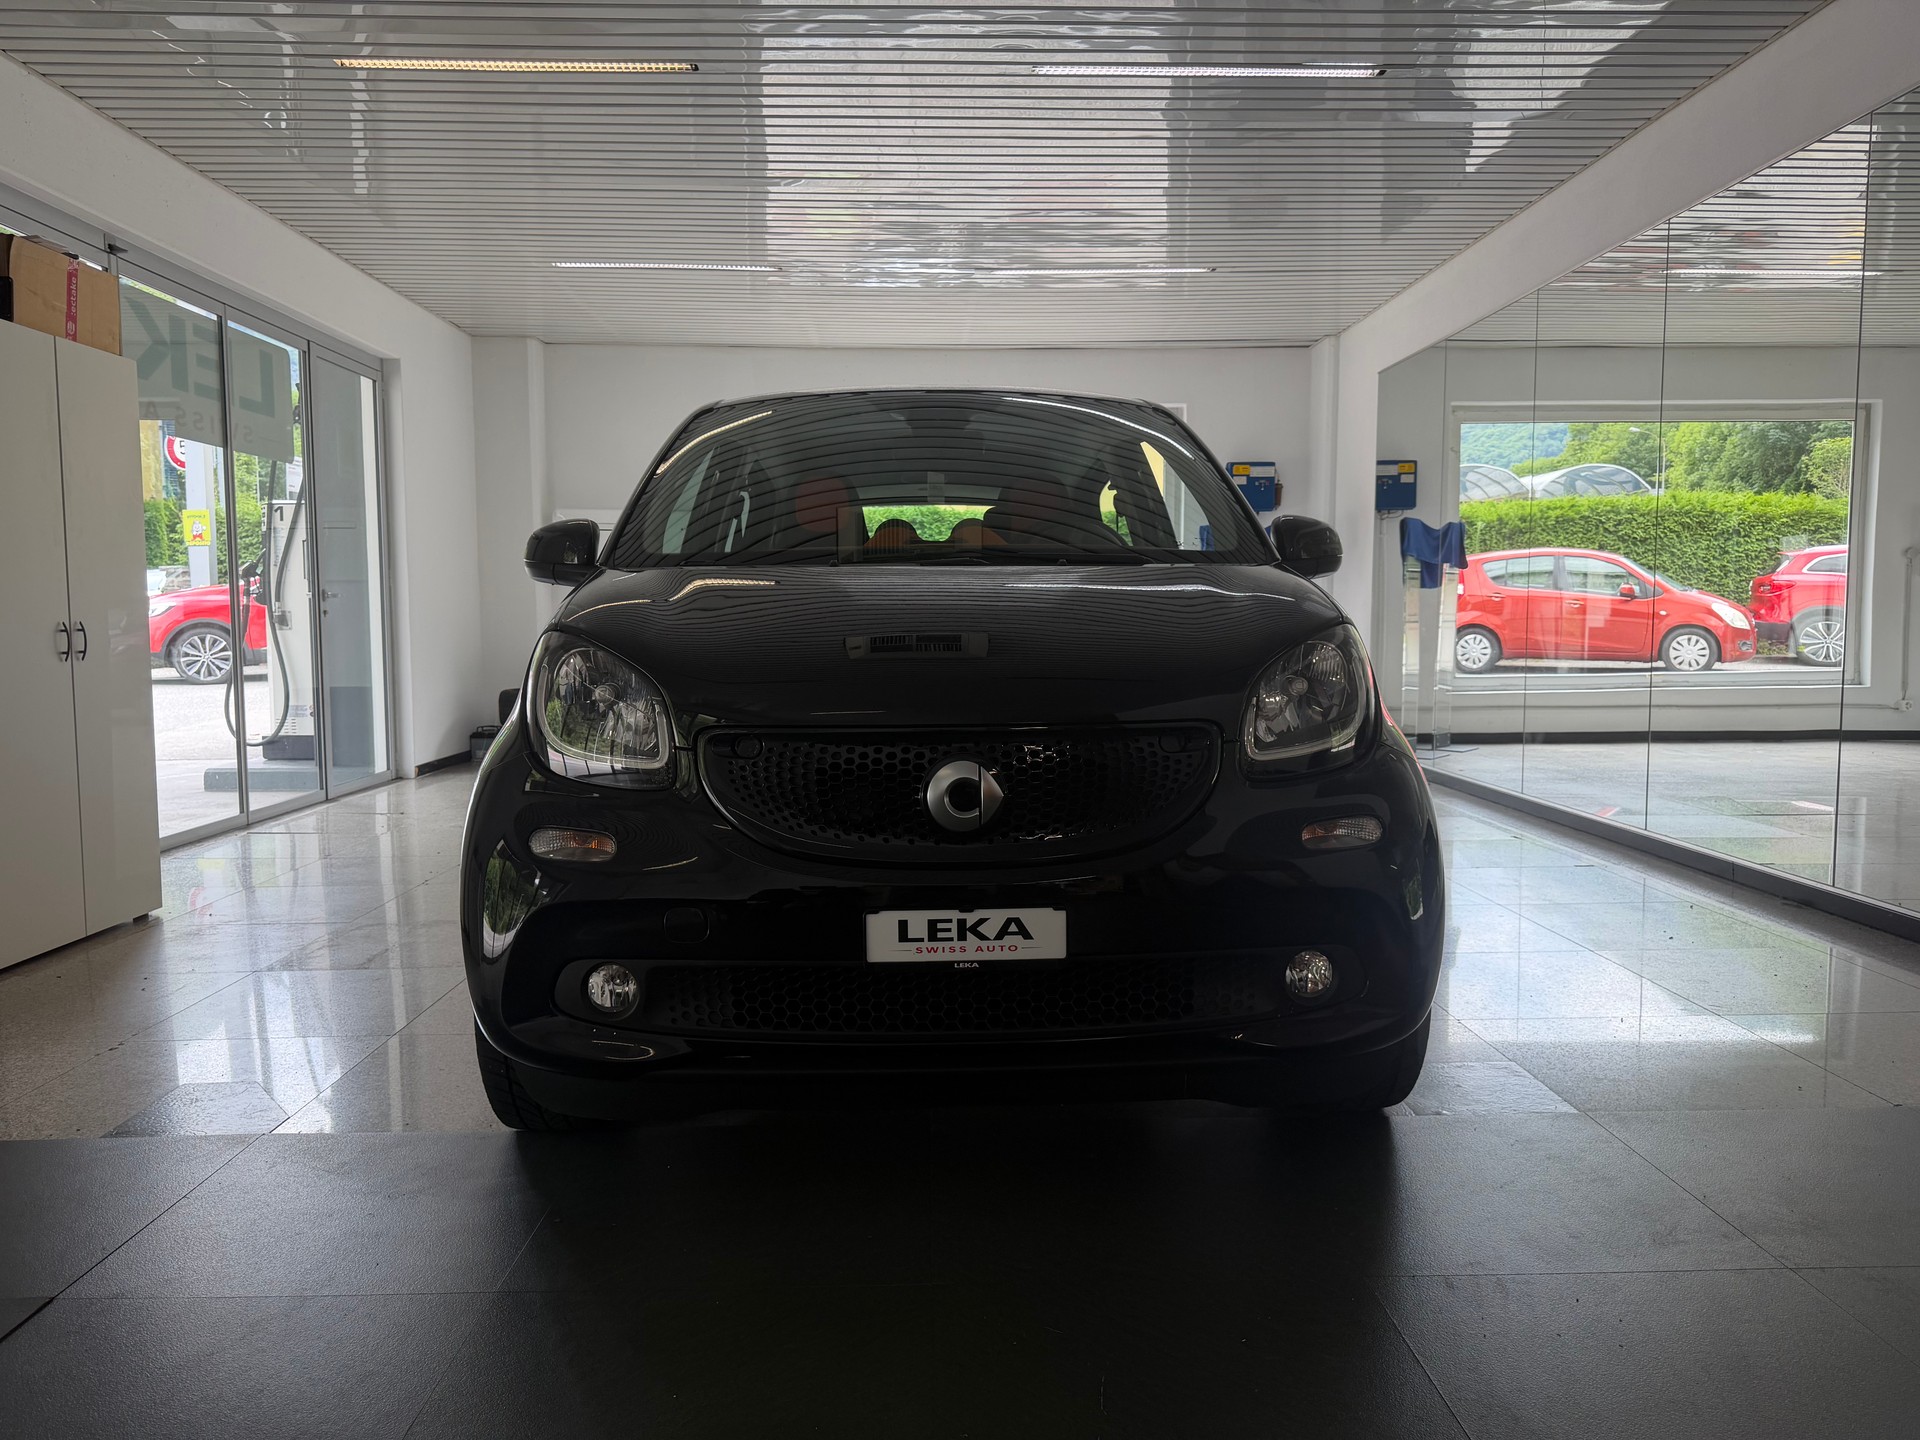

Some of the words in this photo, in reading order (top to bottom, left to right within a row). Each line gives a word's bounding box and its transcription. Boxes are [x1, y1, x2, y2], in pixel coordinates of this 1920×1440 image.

[274, 506, 284, 522] 1
[898, 917, 1034, 943] LEKA
[915, 945, 967, 954] SWISS
[975, 944, 1019, 953] AUTO
